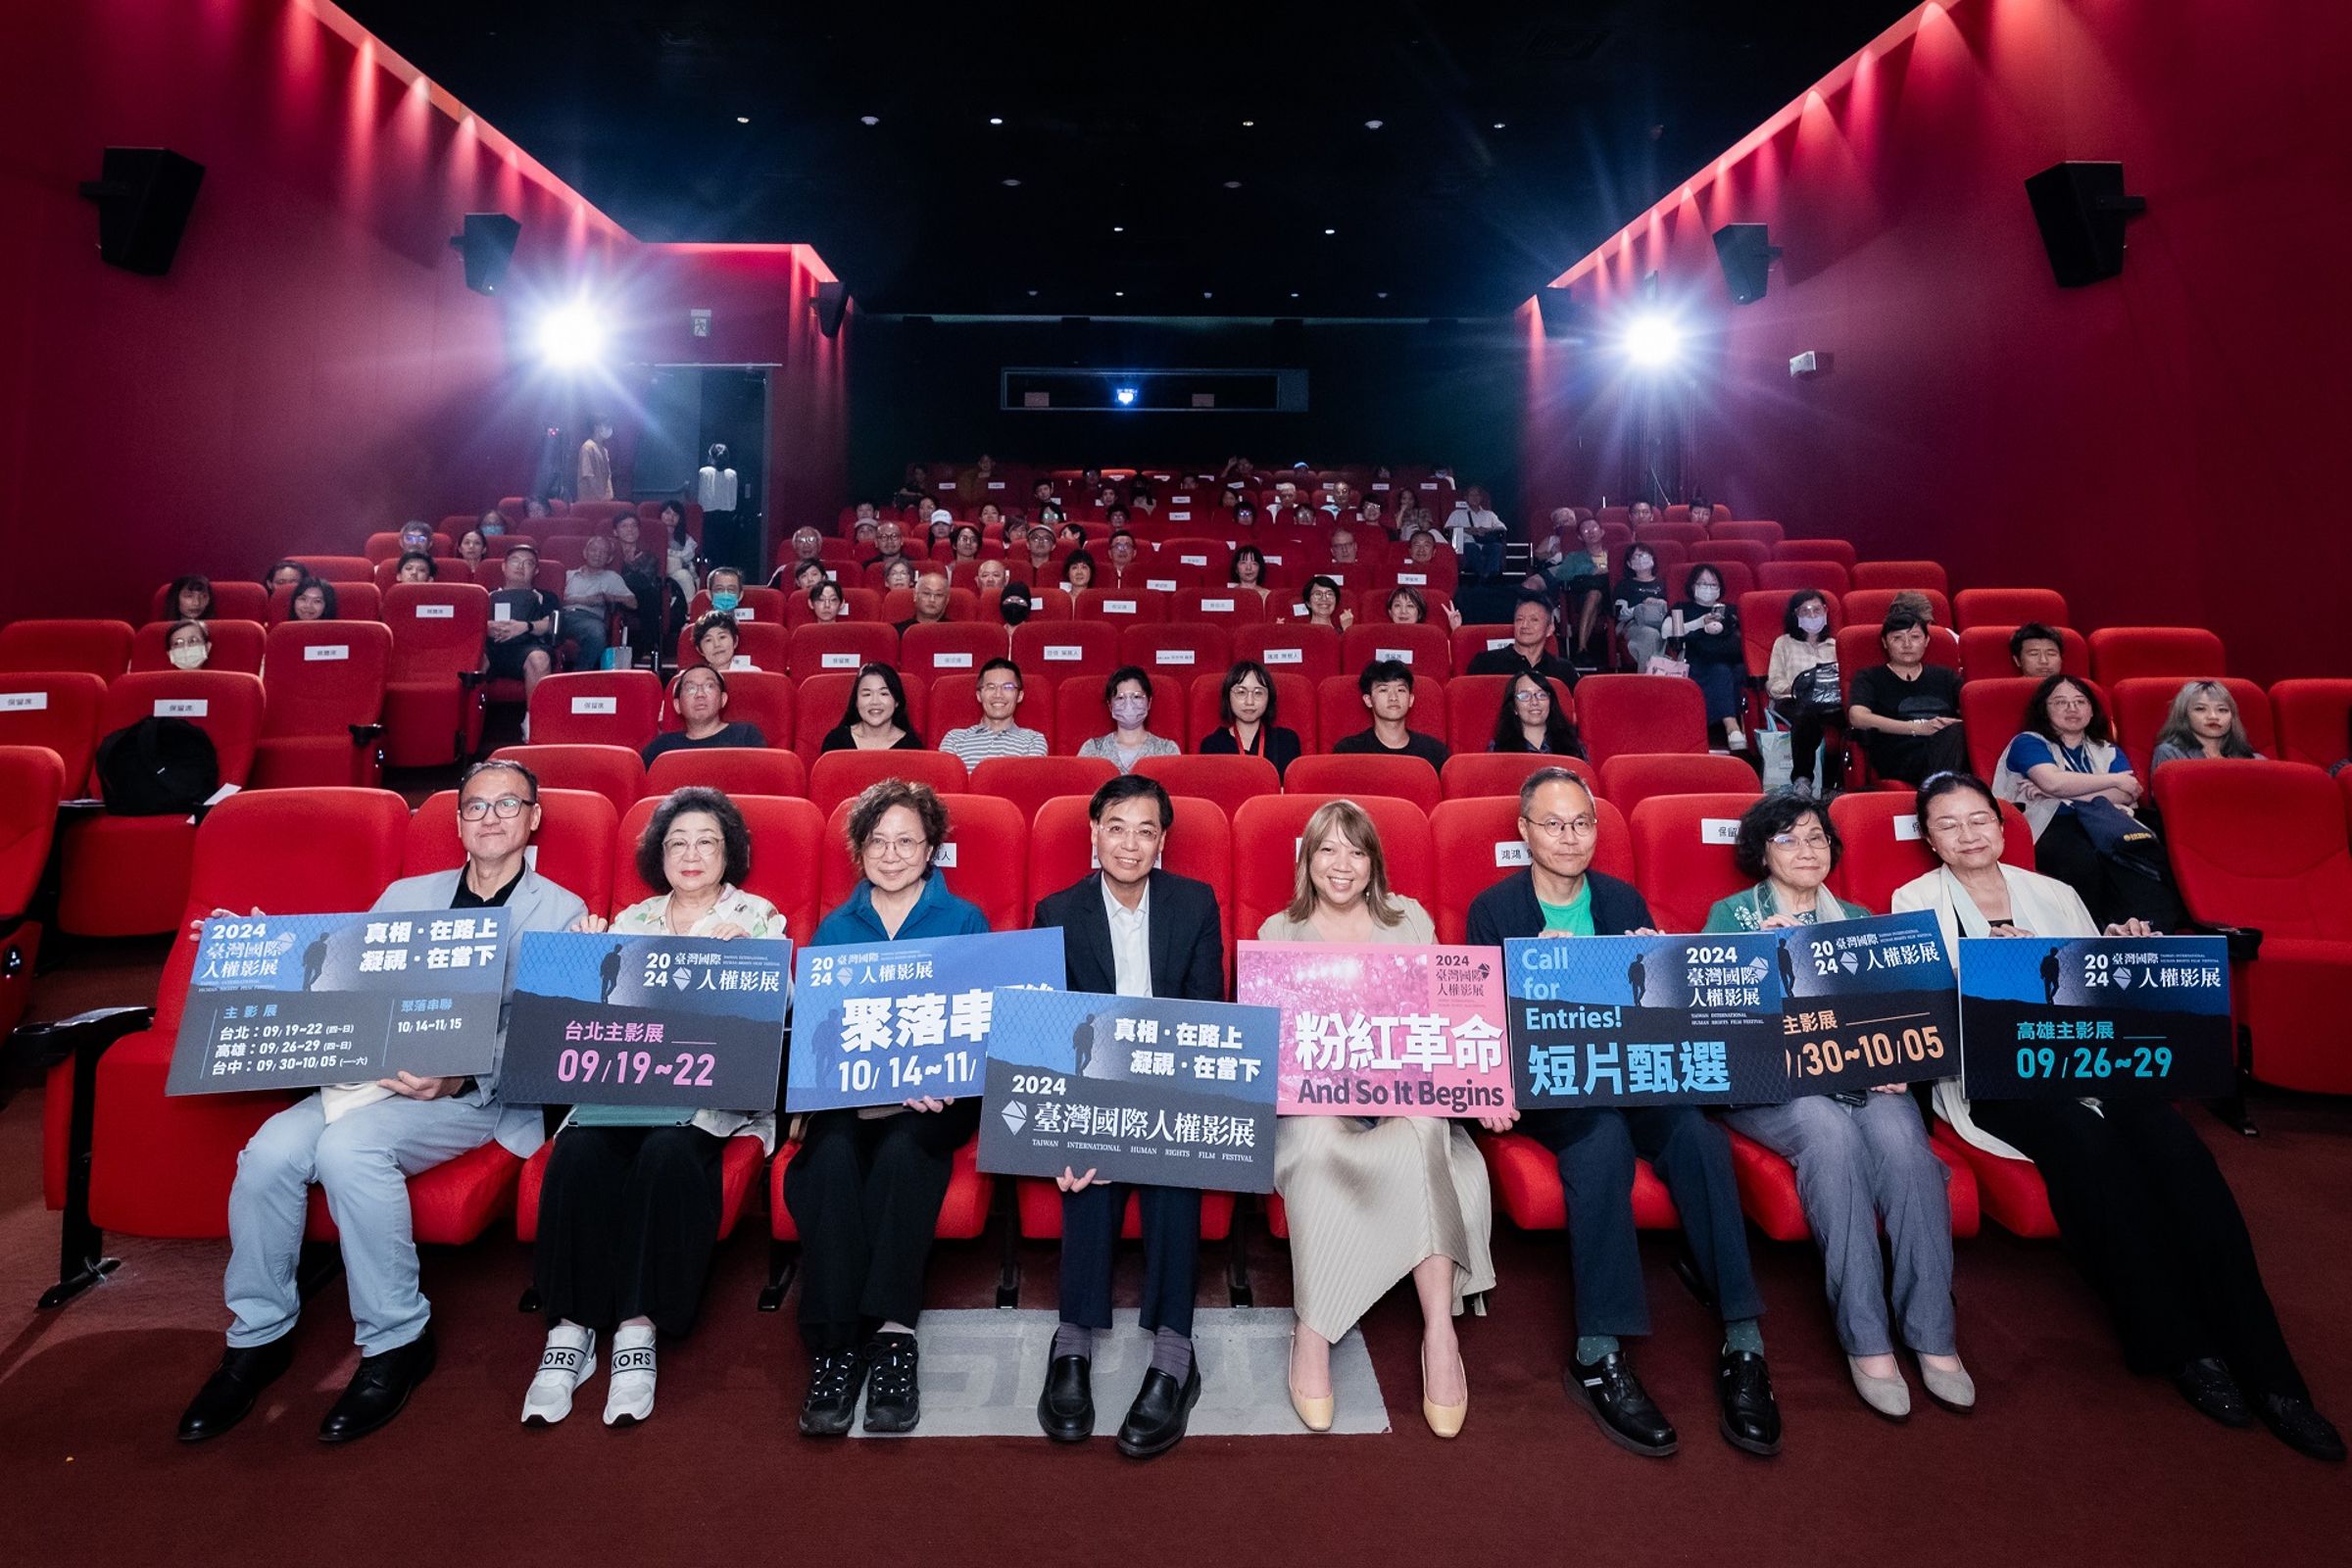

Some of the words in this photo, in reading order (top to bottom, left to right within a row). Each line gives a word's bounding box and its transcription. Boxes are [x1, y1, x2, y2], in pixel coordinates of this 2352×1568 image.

[1718, 826, 1740, 838] 保留
[211, 923, 267, 940] 2024
[206, 940, 283, 959] 臺灣國際
[1810, 940, 1835, 957] 20
[1836, 933, 1879, 950] 臺灣國際
[645, 953, 671, 969] 20
[673, 952, 722, 966] 臺灣國際
[810, 956, 835, 972] 20
[836, 952, 880, 966] 臺灣國際
[1436, 955, 1470, 966] 2024
[1521, 947, 1568, 971] Call
[1686, 947, 1739, 964] 2024
[1866, 940, 1940, 971] 人權影展
[2083, 954, 2109, 969] 20
[2112, 953, 2159, 965] 臺灣國際
[200, 959, 279, 978] 人權影展
[858, 960, 934, 986] 人權影展
[1436, 968, 1484, 982] 臺灣國際
[1815, 957, 1838, 976] 24
[642, 970, 668, 988] 24
[696, 968, 781, 993] 人權影展
[809, 972, 834, 988] 24
[1687, 966, 1759, 987] 臺灣國際
[2083, 971, 2110, 987] 24
[2138, 967, 2222, 988] 人權影展
[1437, 983, 1485, 997] 人權影展
[1522, 977, 1561, 1001] for
[1688, 987, 1761, 1008] 人權影展
[223, 1004, 278, 1019] 主影展
[840, 986, 996, 1054] 聚落串
[1525, 1005, 1623, 1031] Entries!
[564, 1019, 664, 1044] 台北主影展
[1782, 1009, 1838, 1036] 主影展
[2016, 1020, 2115, 1041] 高雄主影展
[1295, 1010, 1504, 1074] 粉紅革命
[1785, 1025, 1945, 1079] /30~10/05
[1528, 1041, 1732, 1097] 短片甄選
[1010, 1074, 1067, 1097] 2024
[1297, 1078, 1350, 1105] And
[1355, 1078, 1390, 1105] So
[1394, 1079, 1414, 1105] It
[1417, 1078, 1505, 1113] Begins
[1032, 1101, 1256, 1150] 臺灣國際人權影展
[1031, 1138, 1059, 1148] TAIWAN
[1066, 1141, 1122, 1153] INTERNATIONAL
[1130, 1145, 1157, 1155] HUMAN
[1164, 1148, 1191, 1158] RIGHTS
[1198, 1151, 1216, 1159] FILM
[1221, 1152, 1254, 1163] FESTIVAL
